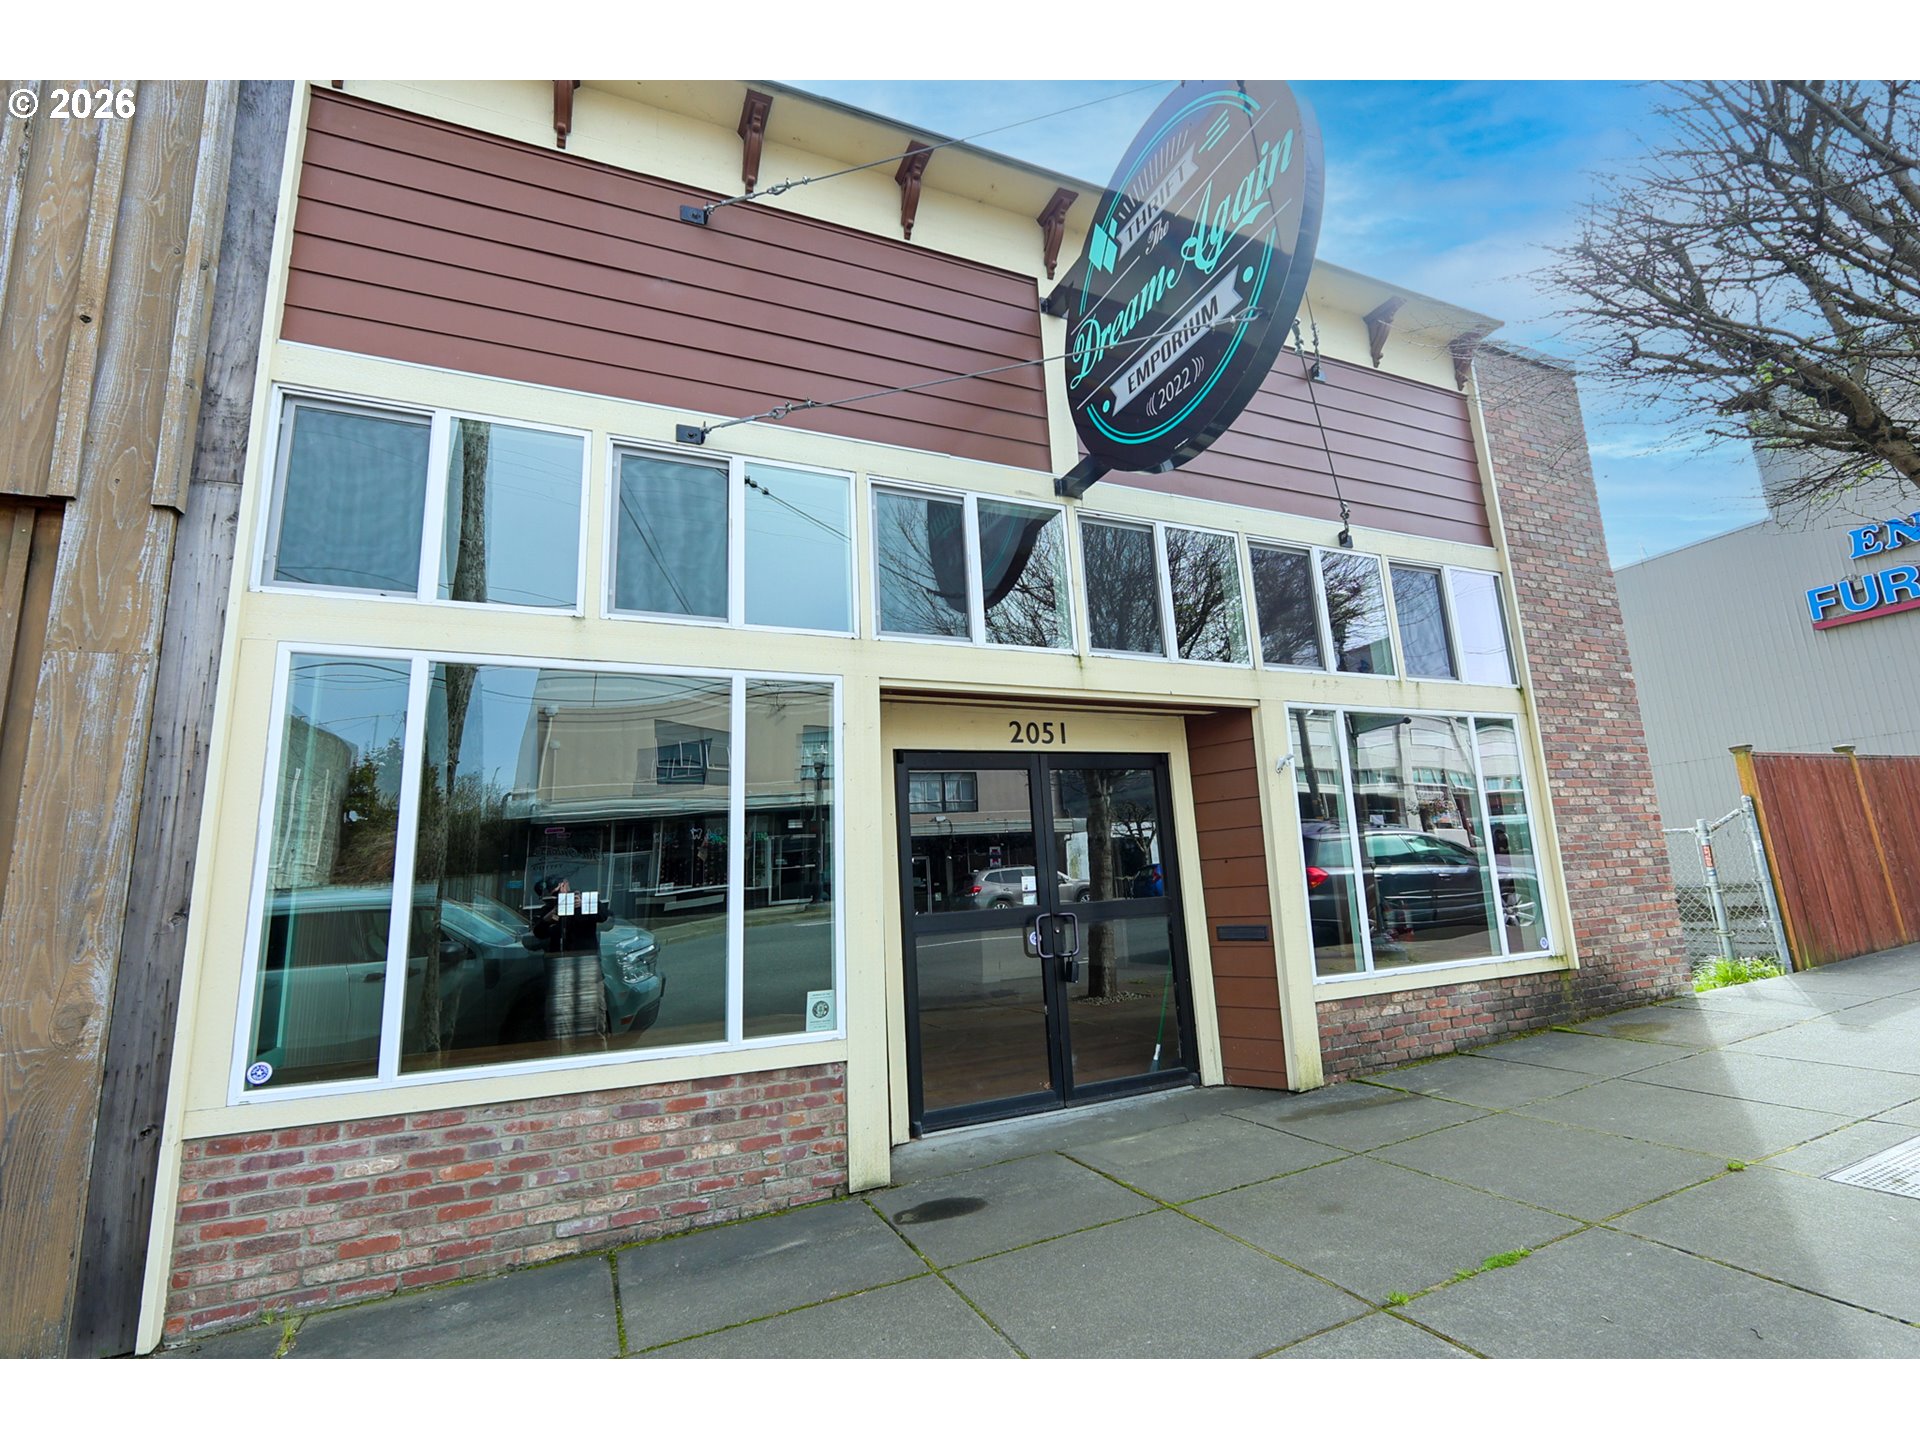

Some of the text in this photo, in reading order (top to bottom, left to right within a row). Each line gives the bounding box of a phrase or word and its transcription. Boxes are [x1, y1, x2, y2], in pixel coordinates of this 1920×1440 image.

[1124, 160, 1184, 242] THRIFT
[1181, 128, 1294, 275] Again
[1145, 218, 1169, 255] The
[1127, 295, 1219, 394] EMPORIUM
[1805, 565, 1920, 621] FUR
[1009, 720, 1066, 744] 2051
